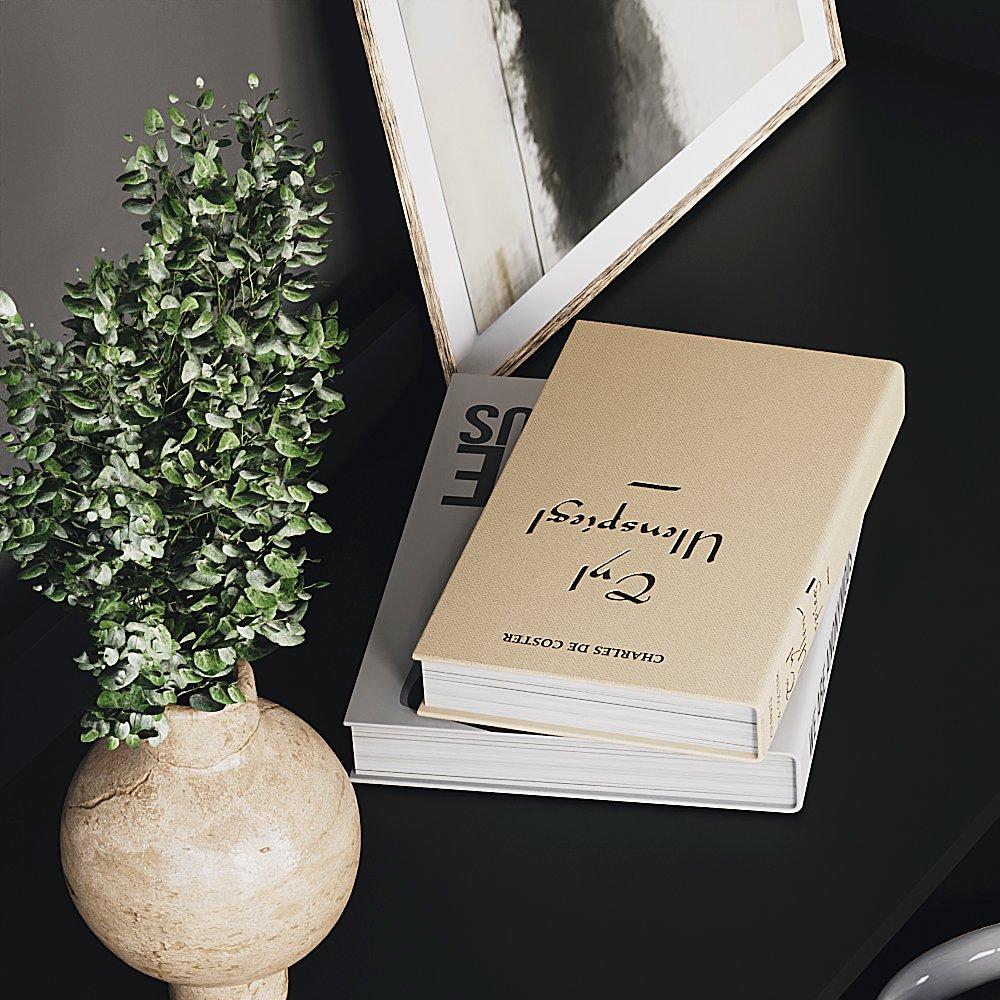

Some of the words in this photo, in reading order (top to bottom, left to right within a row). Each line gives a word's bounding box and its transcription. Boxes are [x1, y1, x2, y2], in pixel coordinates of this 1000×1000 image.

[525, 499, 723, 563] Ulenspiegl
[568, 549, 656, 604] Tyl
[502, 632, 564, 649] COSTER
[567, 642, 590, 654] DE
[593, 645, 665, 664] CHARLES
